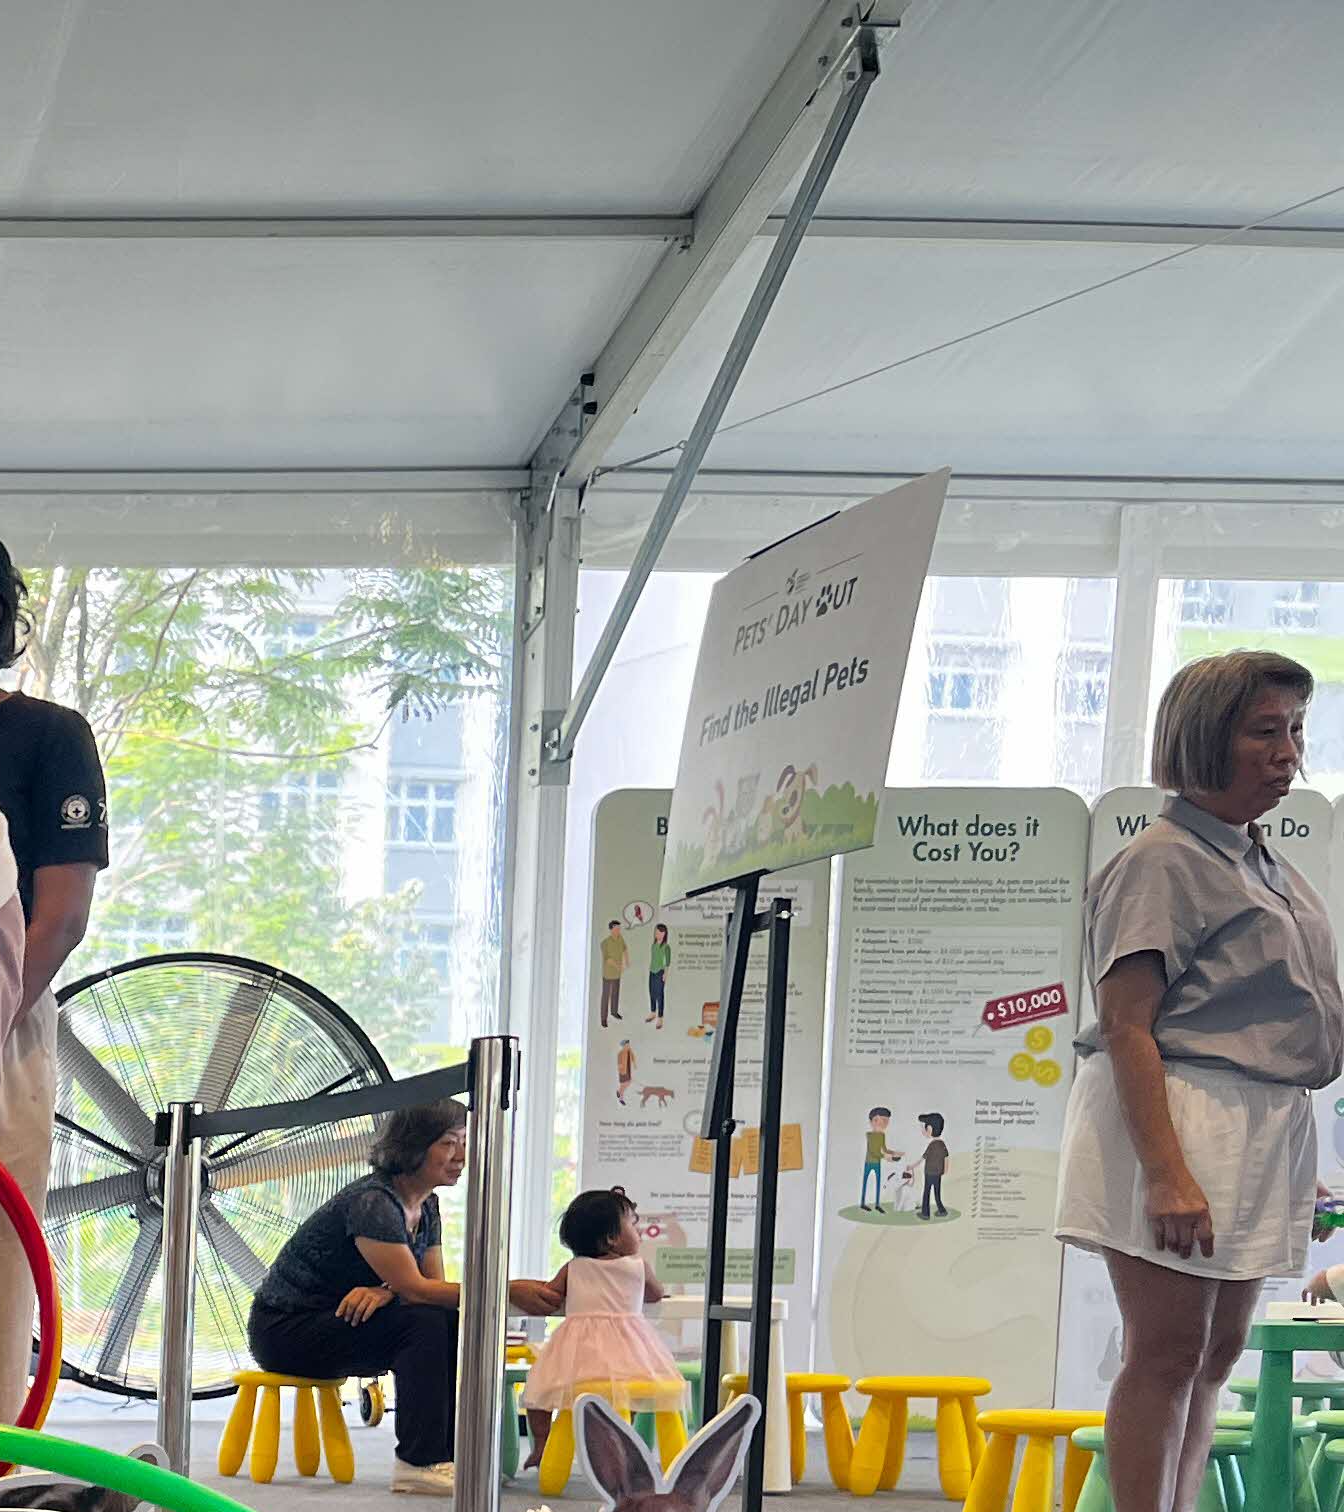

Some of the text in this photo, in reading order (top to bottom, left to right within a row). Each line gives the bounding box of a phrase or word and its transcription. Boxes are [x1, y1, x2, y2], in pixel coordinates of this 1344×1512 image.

[775, 595, 814, 636] DAY
[699, 656, 869, 747] Find the Illegal Pets
[897, 814, 1040, 837] What does it
[1281, 817, 1310, 838] Do
[913, 841, 1020, 862] Cost You?
[997, 989, 1061, 1018] $10,000
